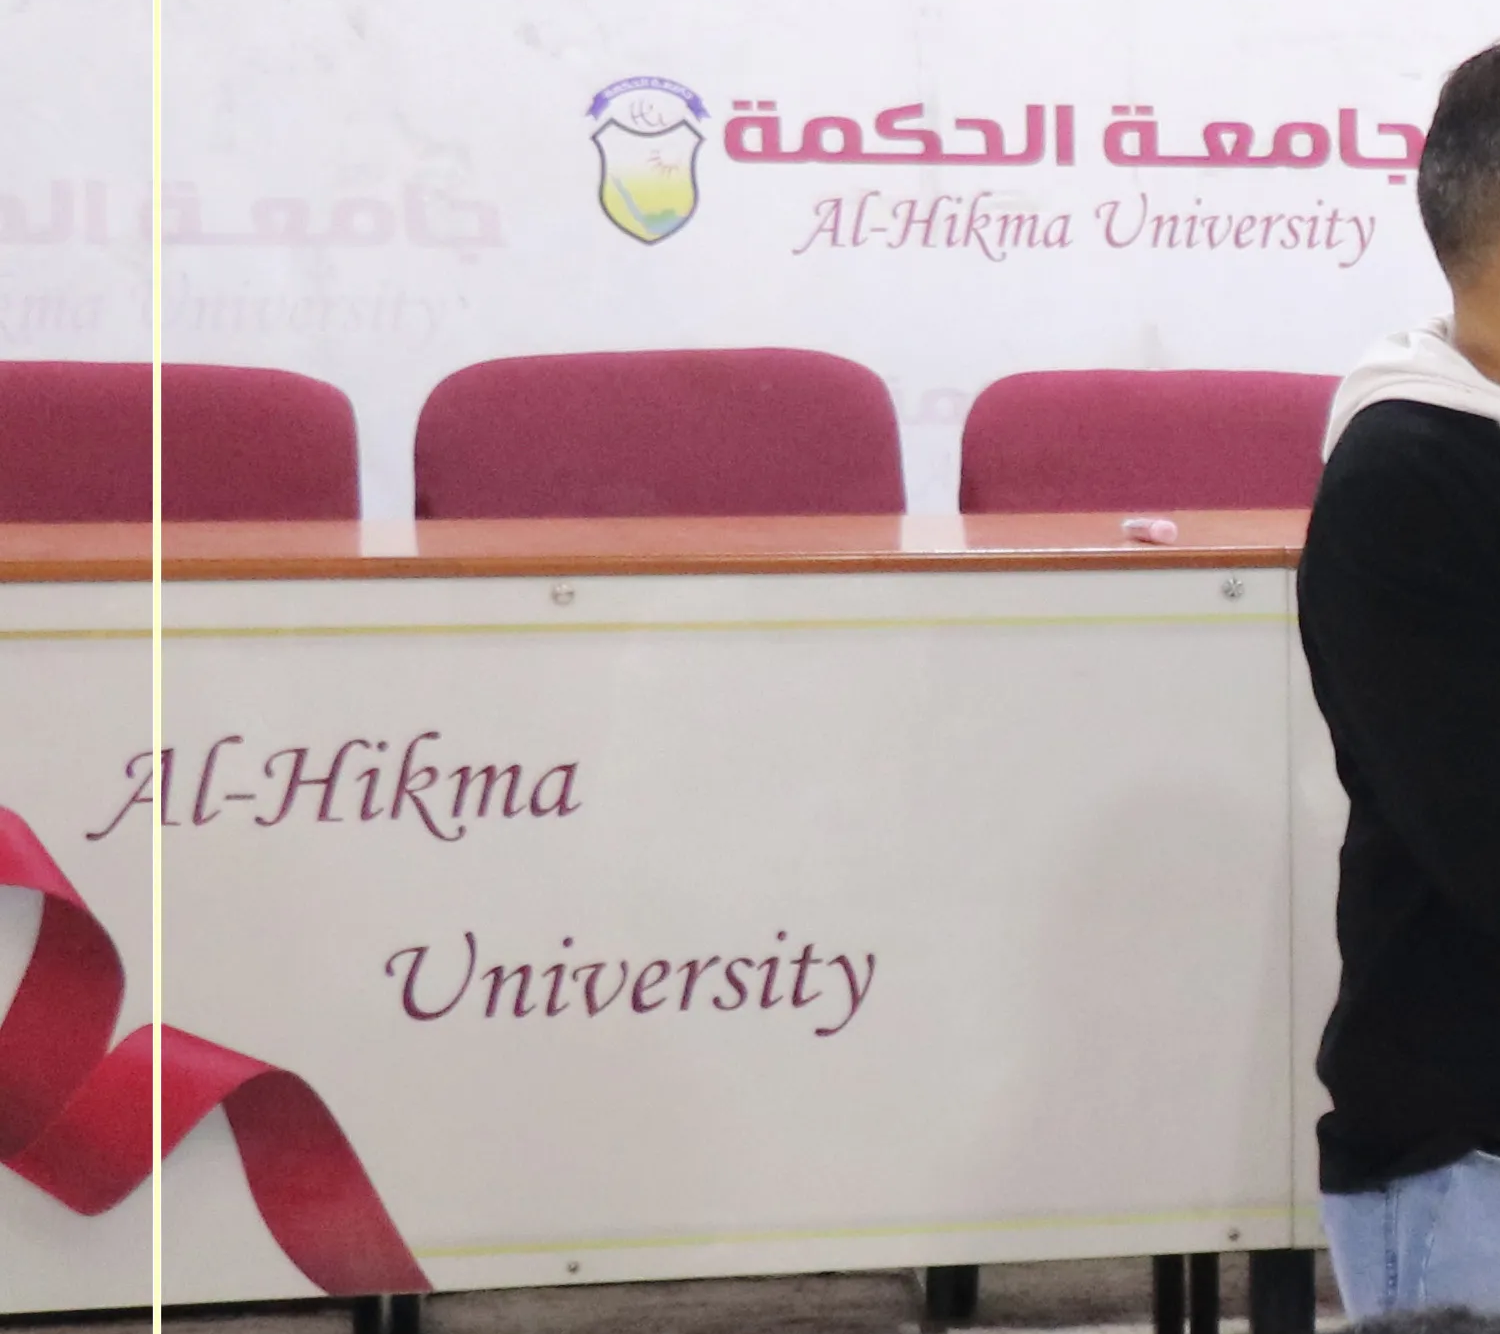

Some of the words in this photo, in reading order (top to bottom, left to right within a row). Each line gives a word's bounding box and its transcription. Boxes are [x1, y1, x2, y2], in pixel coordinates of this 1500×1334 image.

[723, 99, 1075, 166] الحكمة
[1102, 104, 1427, 185] جامعة
[791, 189, 1071, 263] Al-Hikma
[1094, 192, 1376, 269] University
[84, 730, 581, 842] Al-Hikma
[384, 930, 876, 1037] University
